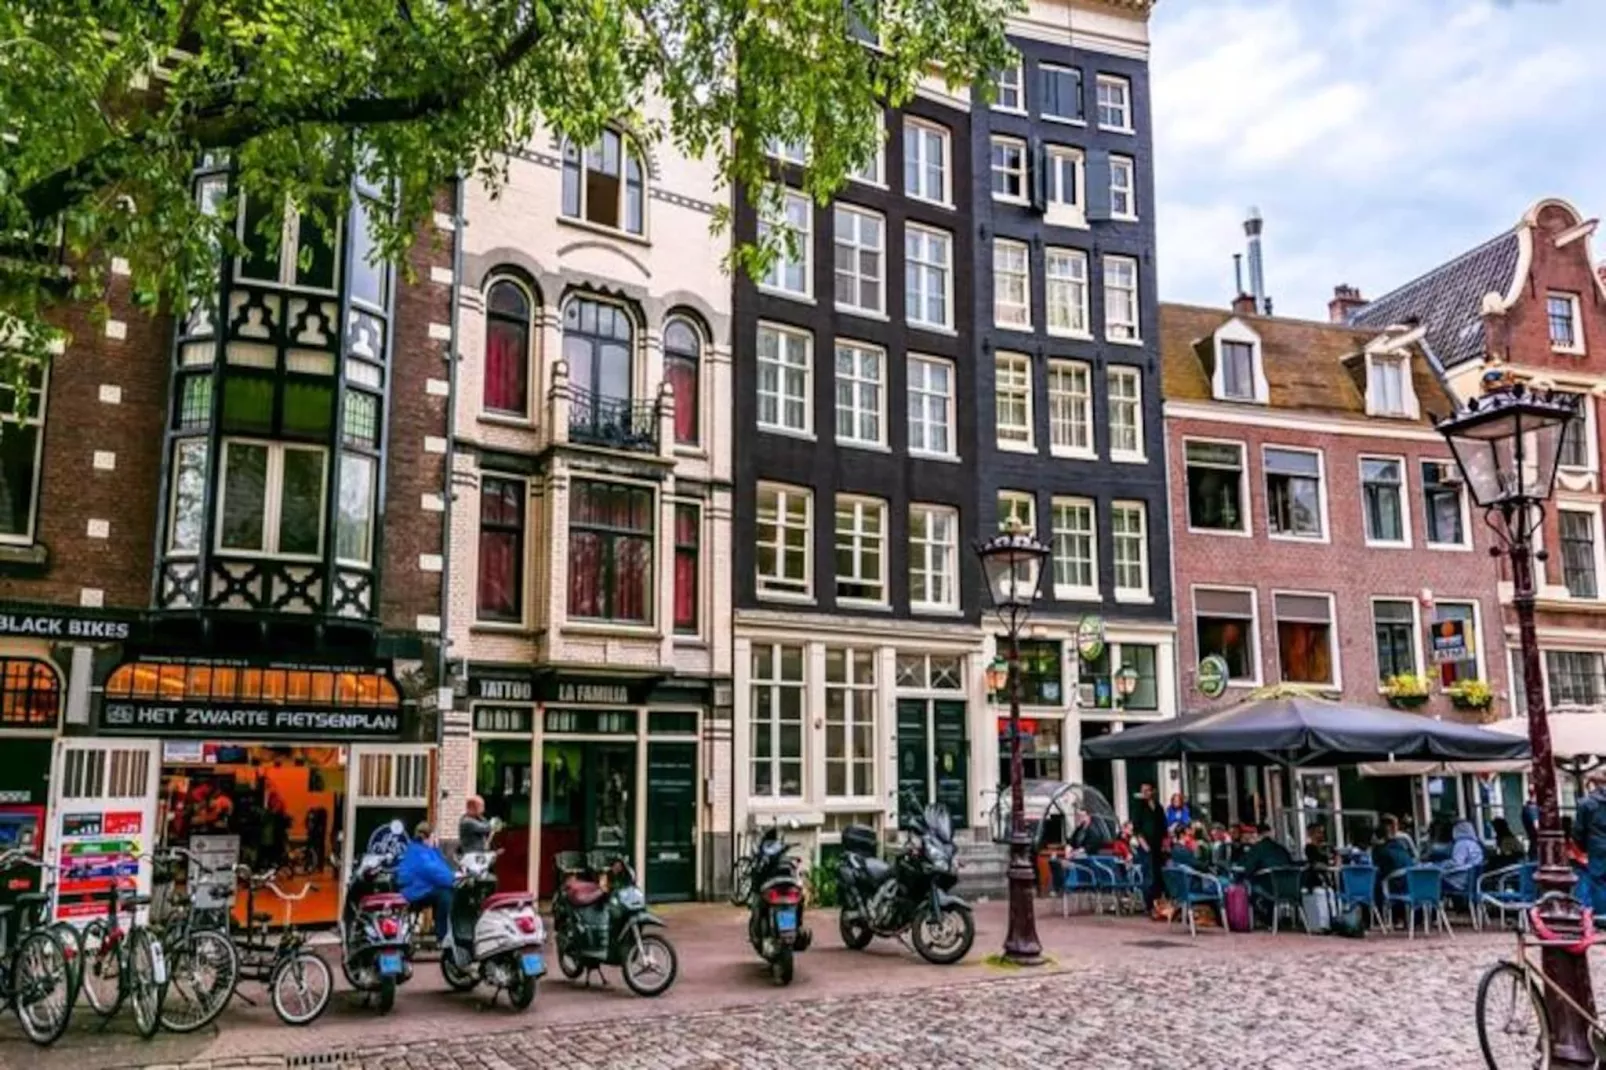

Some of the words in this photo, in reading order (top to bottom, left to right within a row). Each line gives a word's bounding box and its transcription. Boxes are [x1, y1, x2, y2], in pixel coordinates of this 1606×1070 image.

[0, 615, 62, 634] BLACK
[68, 620, 129, 638] BIKES
[480, 679, 532, 699] TATTOO
[558, 683, 576, 701] LA
[577, 684, 628, 703] FAMILIA
[137, 707, 179, 723] HET
[184, 708, 269, 726] ZWARTE
[275, 712, 398, 730] FIETSENPLAN
